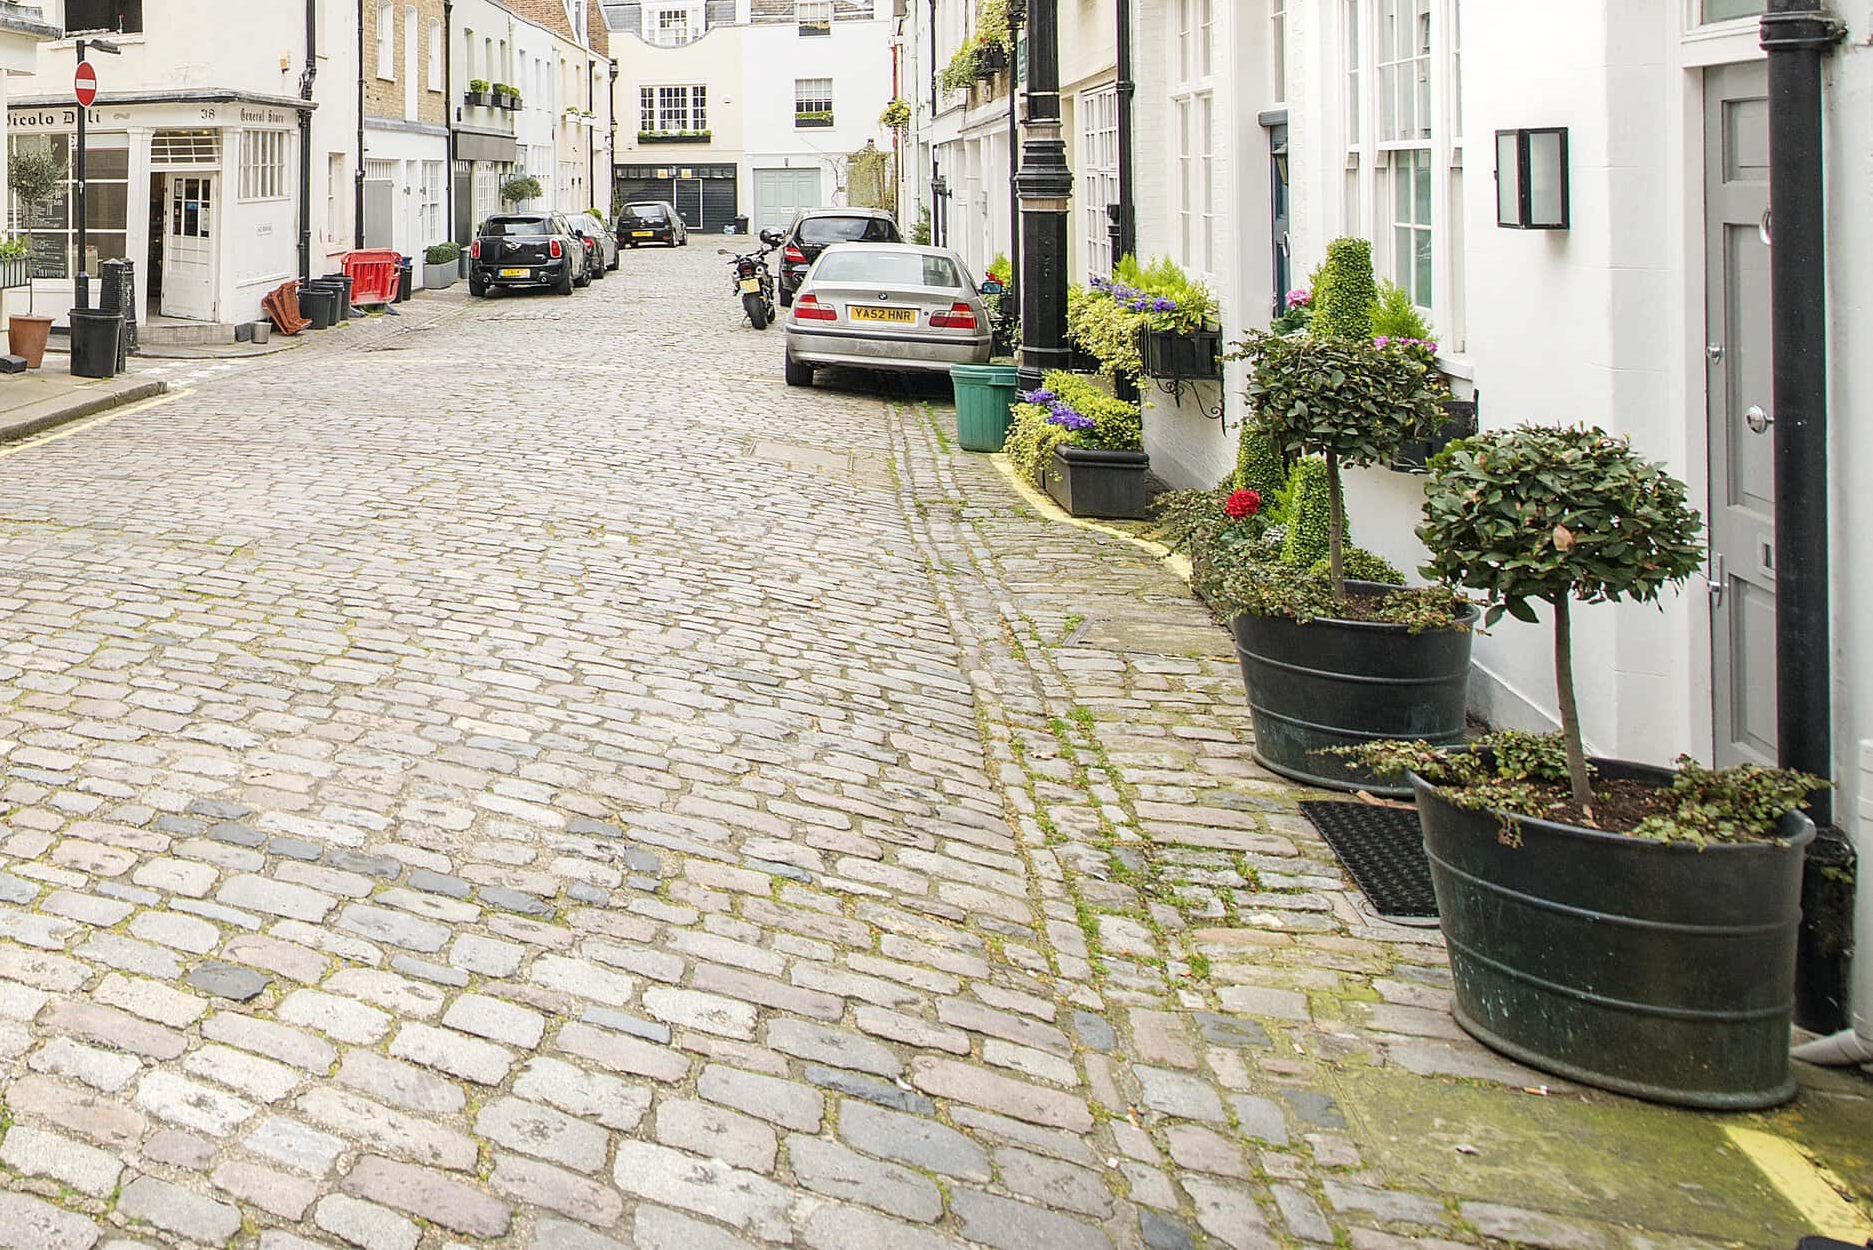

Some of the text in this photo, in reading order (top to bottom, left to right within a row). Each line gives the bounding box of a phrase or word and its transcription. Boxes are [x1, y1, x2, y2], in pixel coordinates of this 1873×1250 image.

[63, 108, 101, 125] Dli
[201, 108, 216, 120] 38
[240, 107, 285, 124] General Store
[855, 308, 911, 321] YA52 HNR
